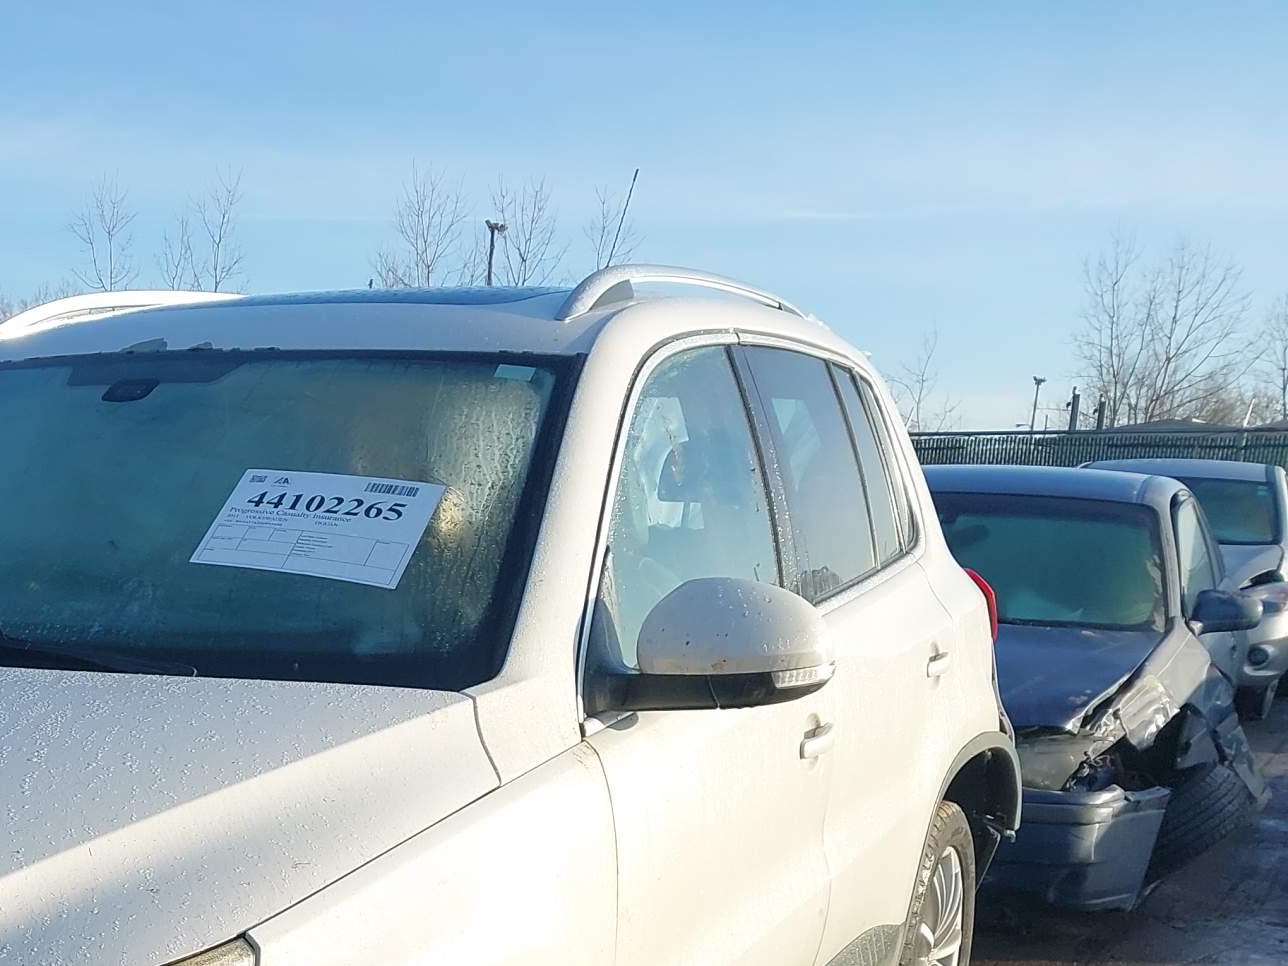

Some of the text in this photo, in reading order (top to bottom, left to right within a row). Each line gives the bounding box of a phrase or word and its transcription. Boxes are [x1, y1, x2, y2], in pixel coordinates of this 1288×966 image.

[246, 489, 408, 521] 44102265
[276, 509, 310, 519] Casualty
[312, 513, 352, 523] Insurance
